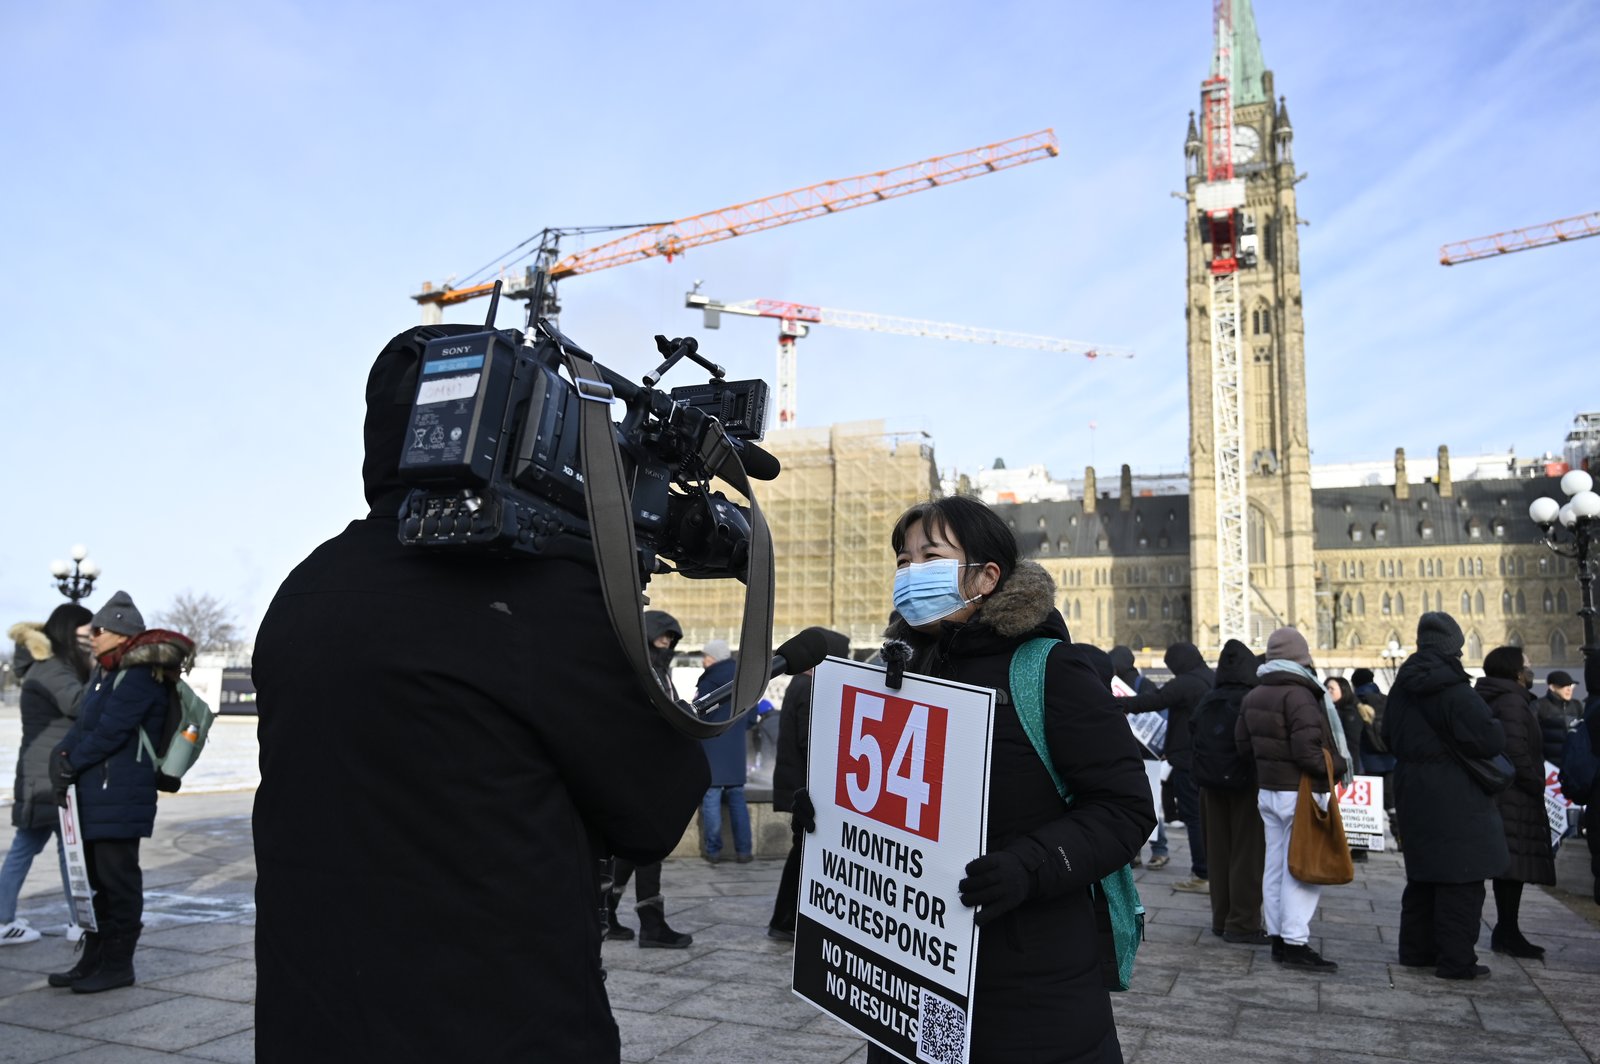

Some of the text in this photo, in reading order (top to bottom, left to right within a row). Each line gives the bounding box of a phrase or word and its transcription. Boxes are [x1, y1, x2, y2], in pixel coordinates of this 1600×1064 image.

[441, 345, 471, 356] SONY
[645, 468, 665, 481] SONY
[845, 691, 930, 832] 54
[842, 821, 923, 878] MONTHS
[1345, 822, 1378, 830] RESPONSE
[822, 848, 946, 929] WAITING FOR
[809, 879, 957, 975] IRCC RESPONSE
[822, 938, 921, 1011] NO TIMELINE
[826, 971, 919, 1043] NO RESULTS
